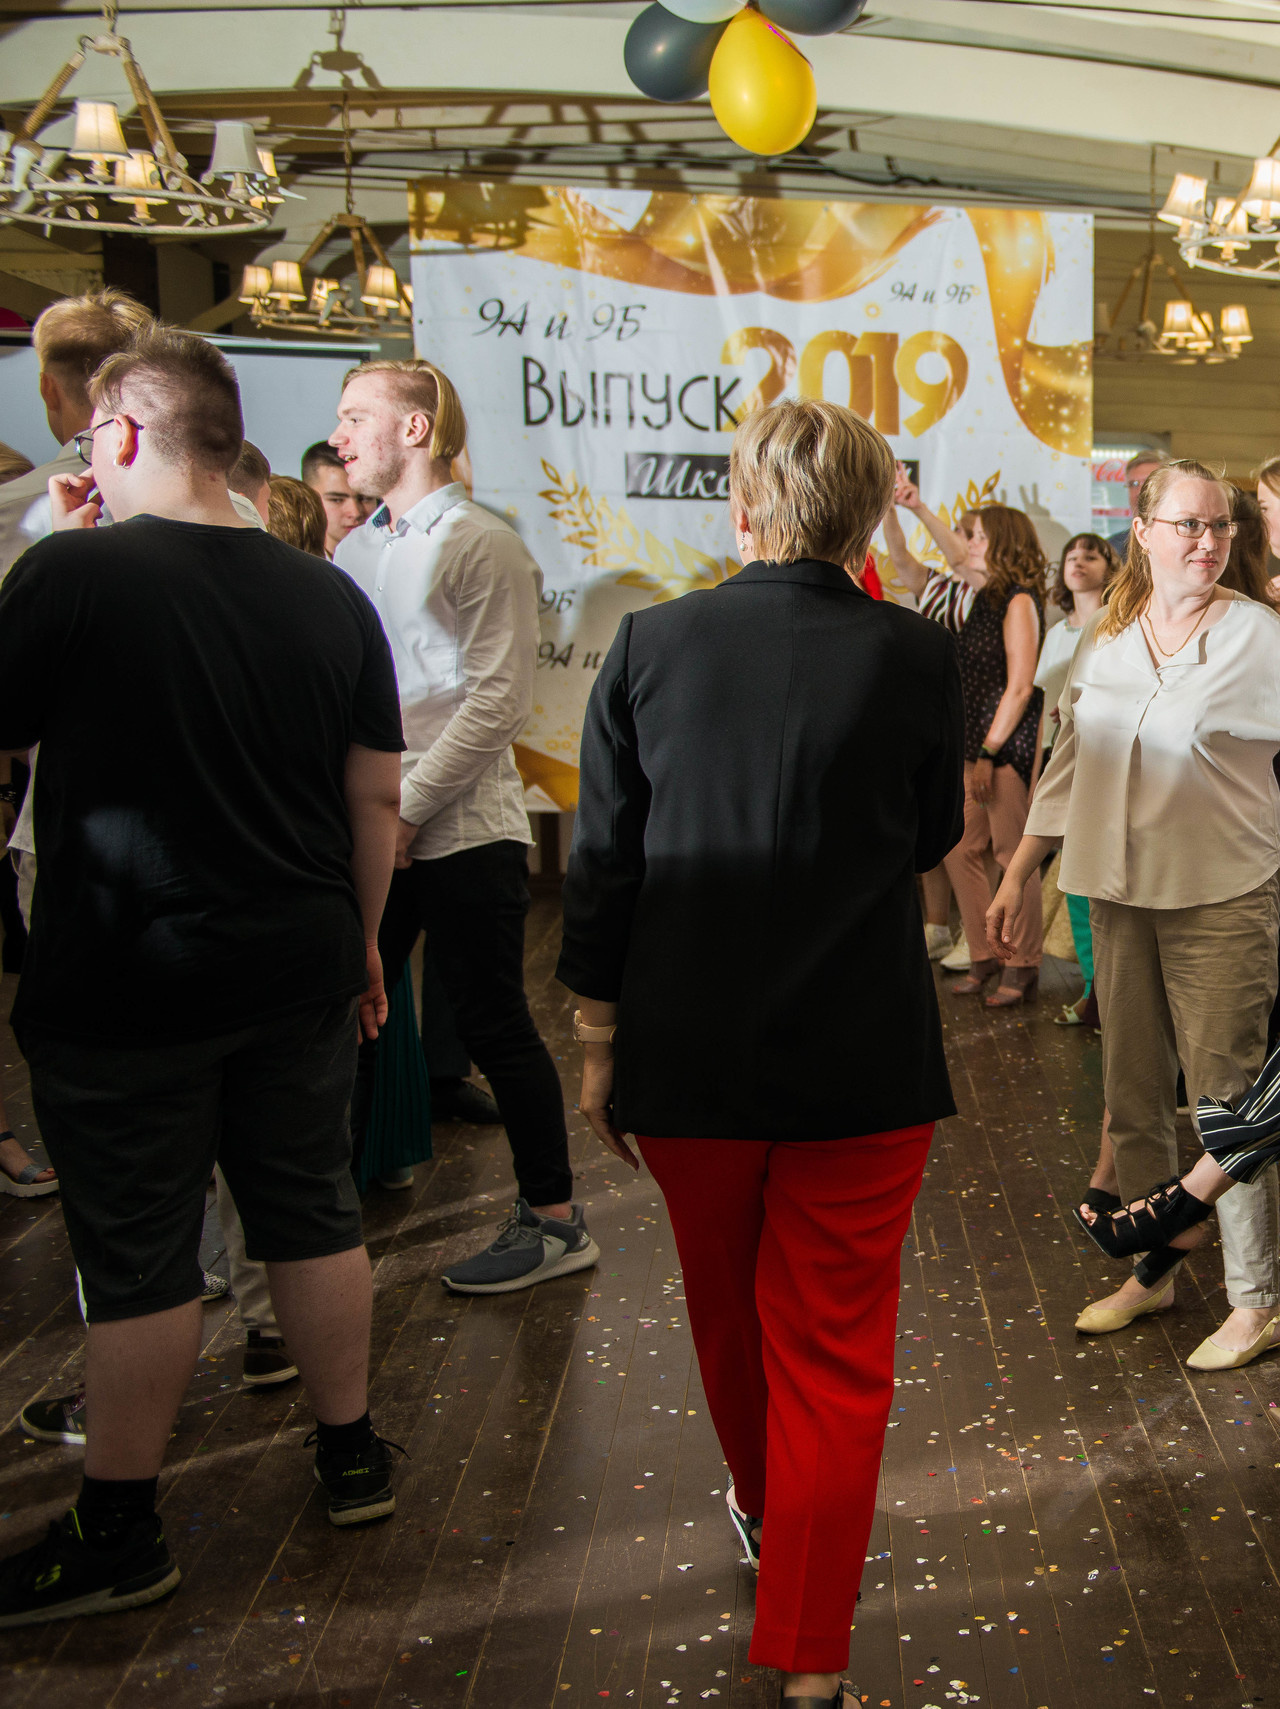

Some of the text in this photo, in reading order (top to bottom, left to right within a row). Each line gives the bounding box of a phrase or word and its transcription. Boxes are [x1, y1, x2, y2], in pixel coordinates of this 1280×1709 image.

[472, 298, 647, 341] 9А и 9Б
[720, 326, 969, 438] 2019
[634, 456, 731, 498] Шко
